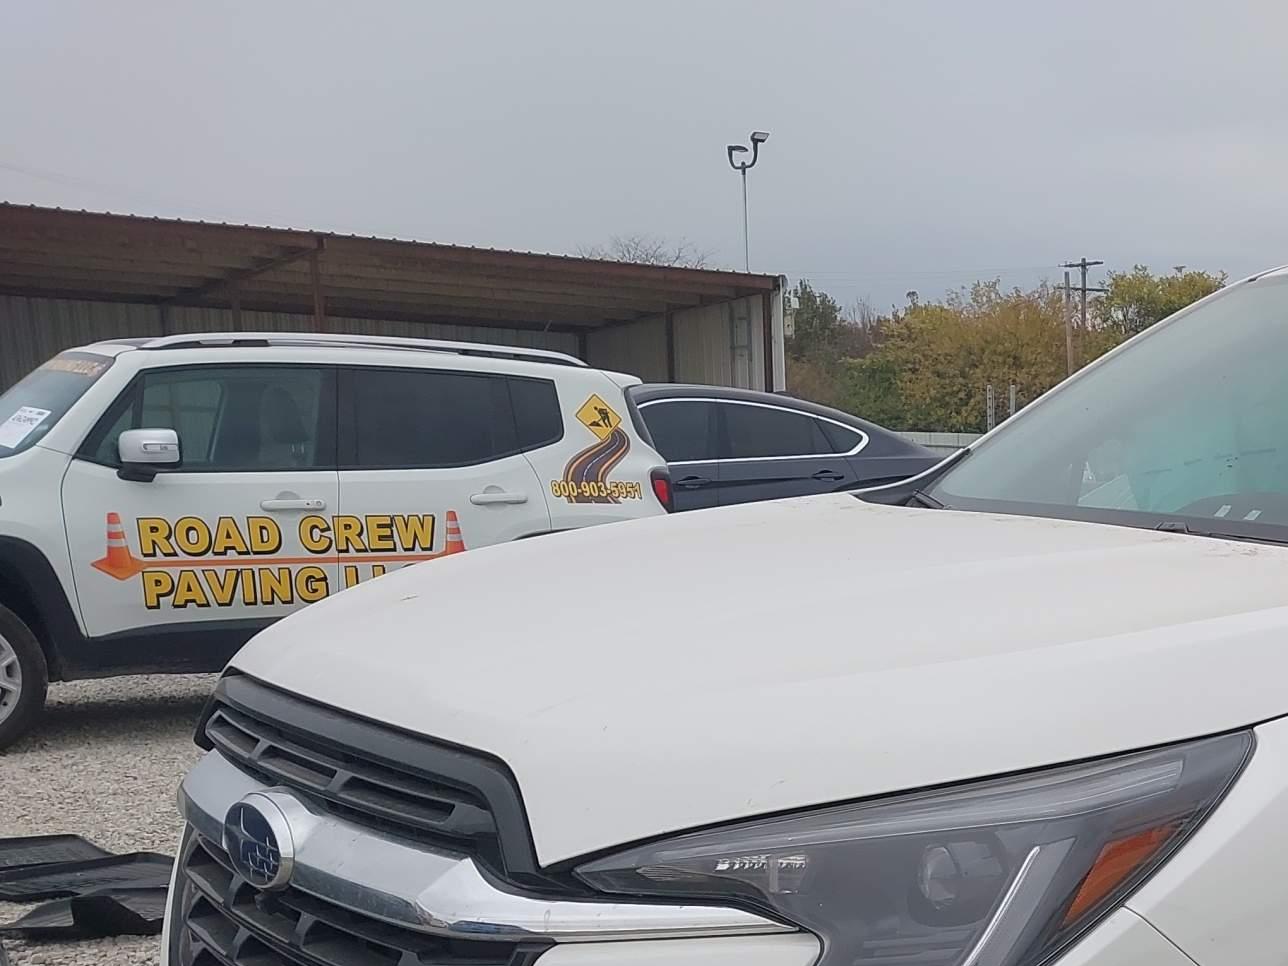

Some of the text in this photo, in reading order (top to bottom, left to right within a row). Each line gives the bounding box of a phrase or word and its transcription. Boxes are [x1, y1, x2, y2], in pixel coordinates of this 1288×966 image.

[551, 480, 643, 500] 800-903-5951
[136, 514, 435, 557] ROAD CREW
[142, 565, 329, 609] PAVING
